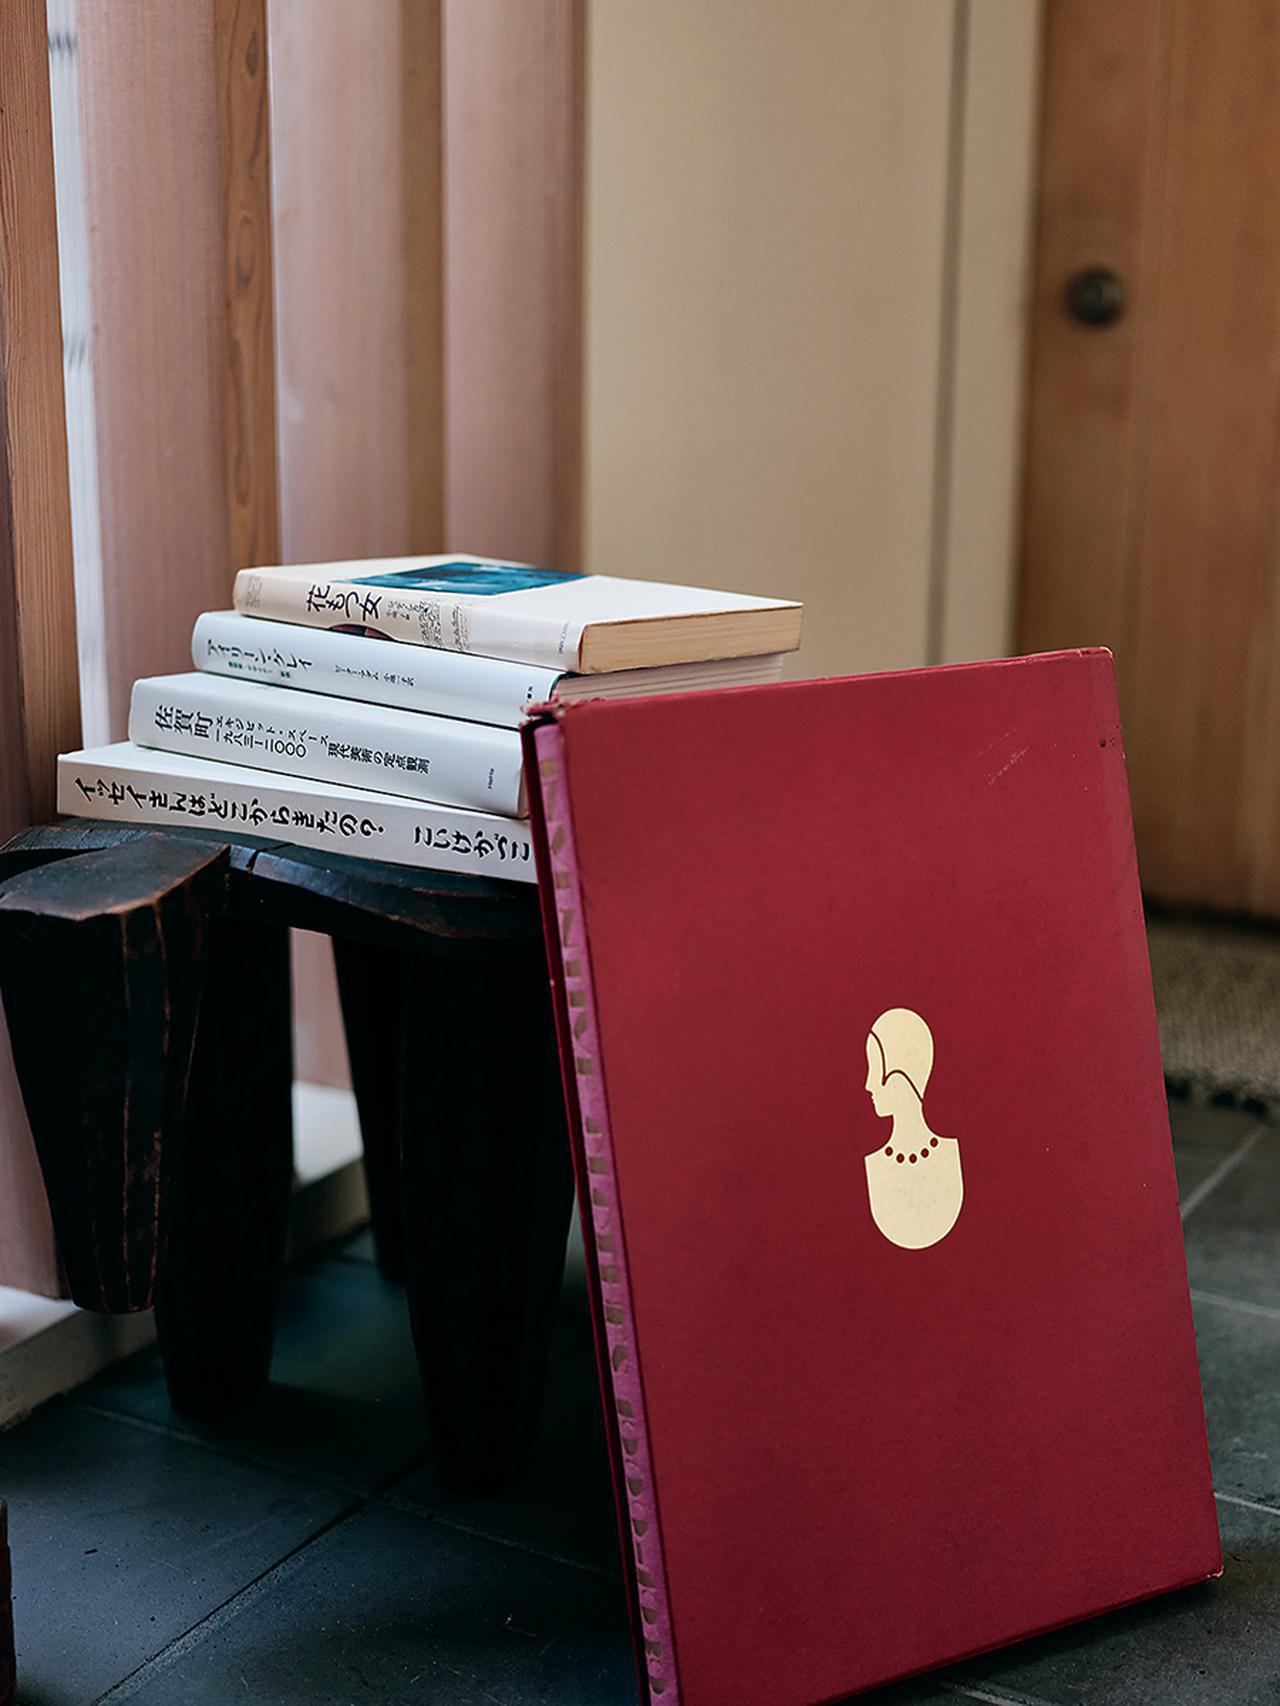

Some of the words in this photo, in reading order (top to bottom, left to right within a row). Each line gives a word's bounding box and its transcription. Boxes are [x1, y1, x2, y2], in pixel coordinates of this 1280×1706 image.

[306, 584, 383, 622] 花もつ女
[207, 638, 313, 671] アイリーン・グレイ
[154, 704, 214, 739] 佐賀町
[327, 742, 431, 775] 現代美術の定点観測
[414, 825, 531, 862] こいけかづこ
